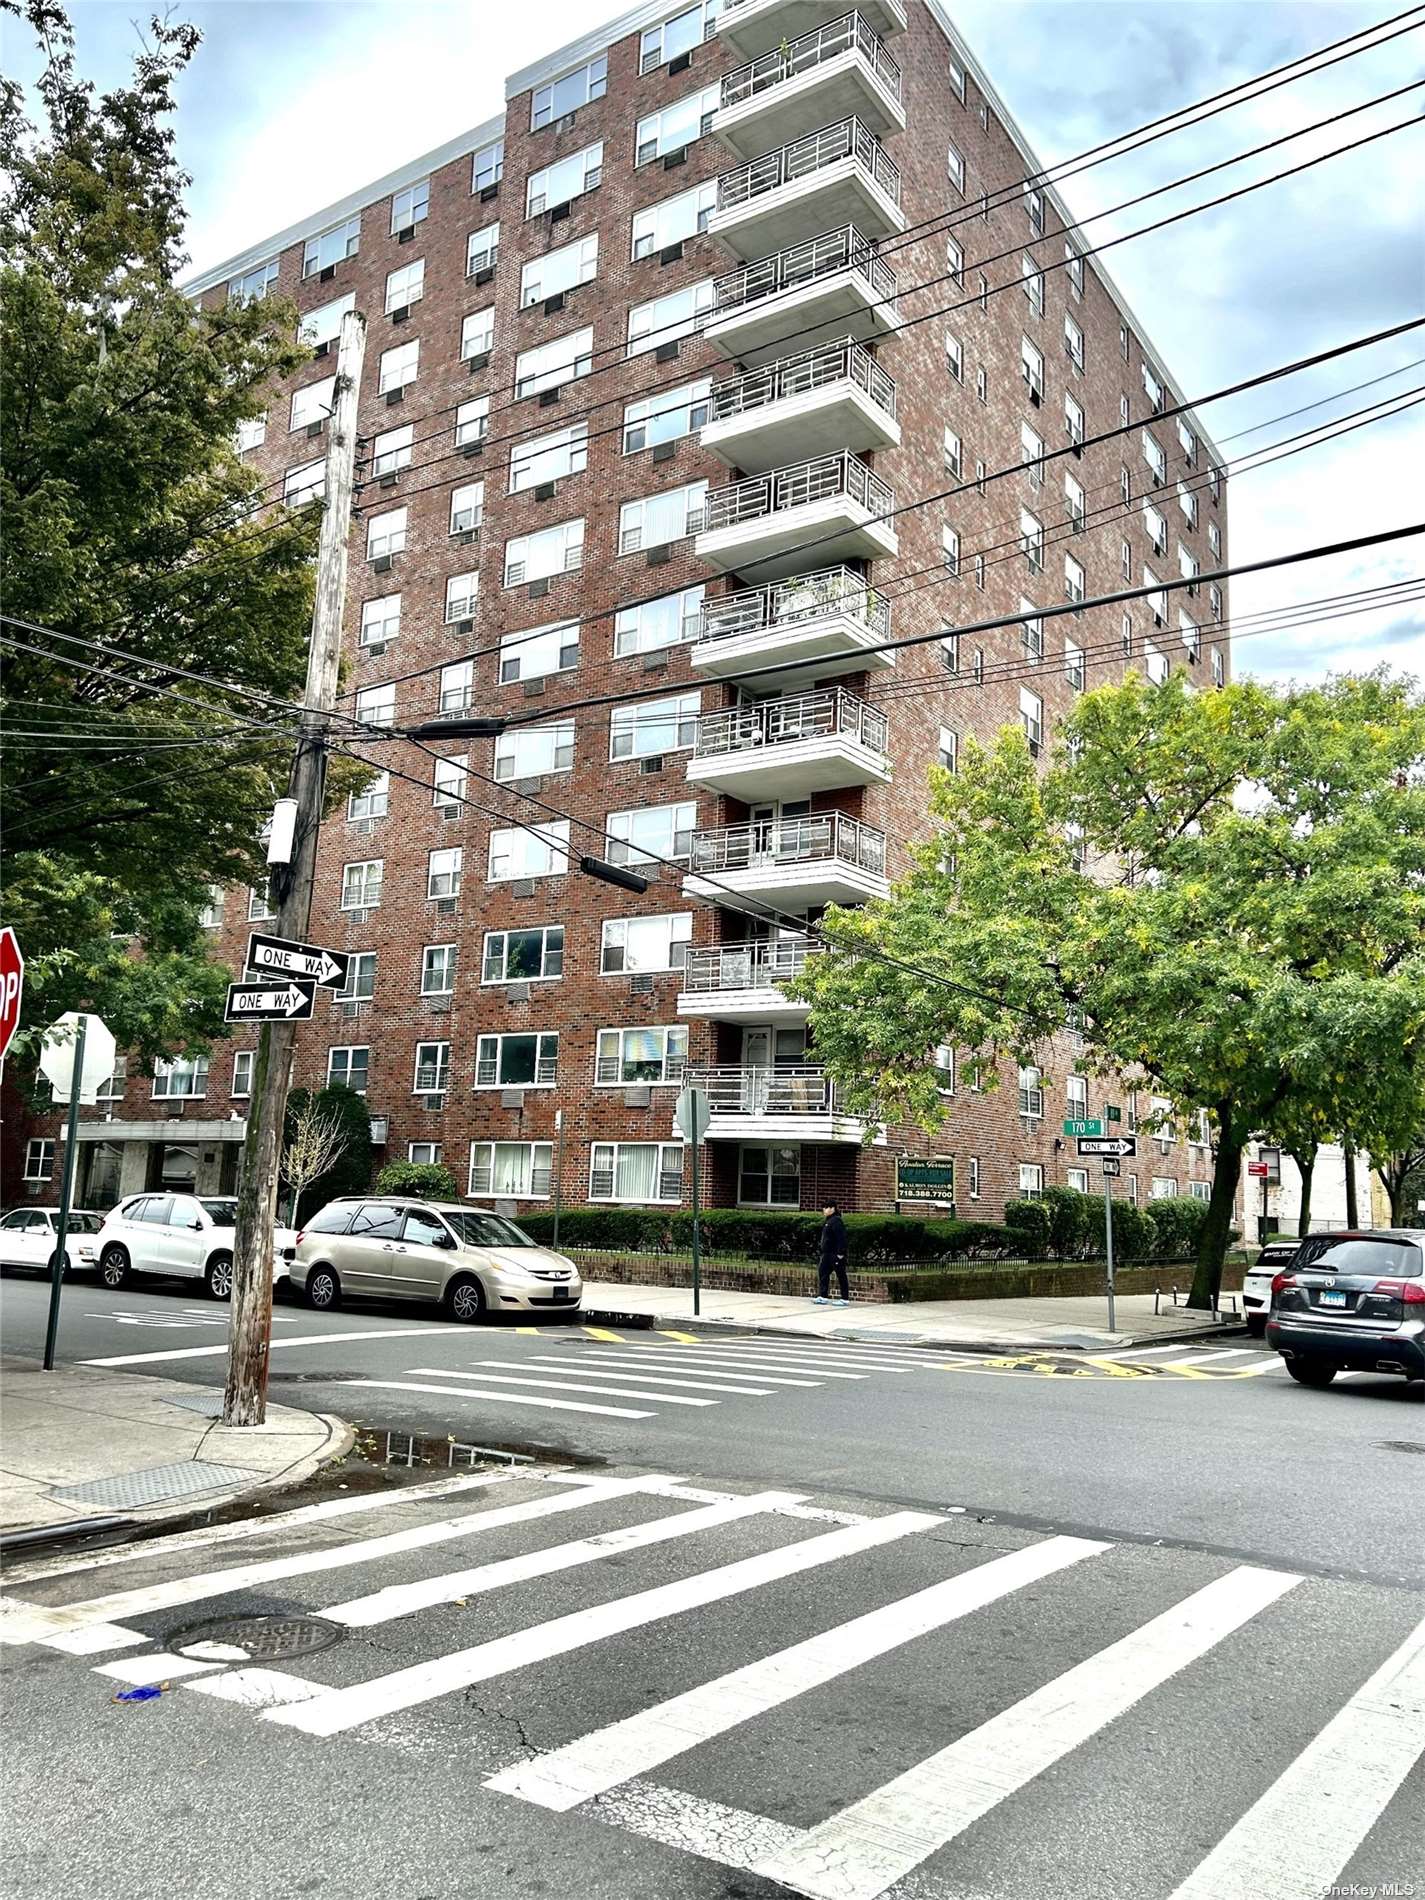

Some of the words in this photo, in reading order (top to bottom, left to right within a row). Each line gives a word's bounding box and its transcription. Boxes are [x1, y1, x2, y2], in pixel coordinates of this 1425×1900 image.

[264, 949, 291, 967] ONE
[305, 958, 333, 976] WAY
[239, 994, 263, 1009] ONE
[274, 993, 300, 1008] WAY
[1072, 1121, 1086, 1133] 170
[1088, 1121, 1095, 1129] St
[1085, 1143, 1102, 1151] ONE
[1108, 1143, 1127, 1151] WAY
